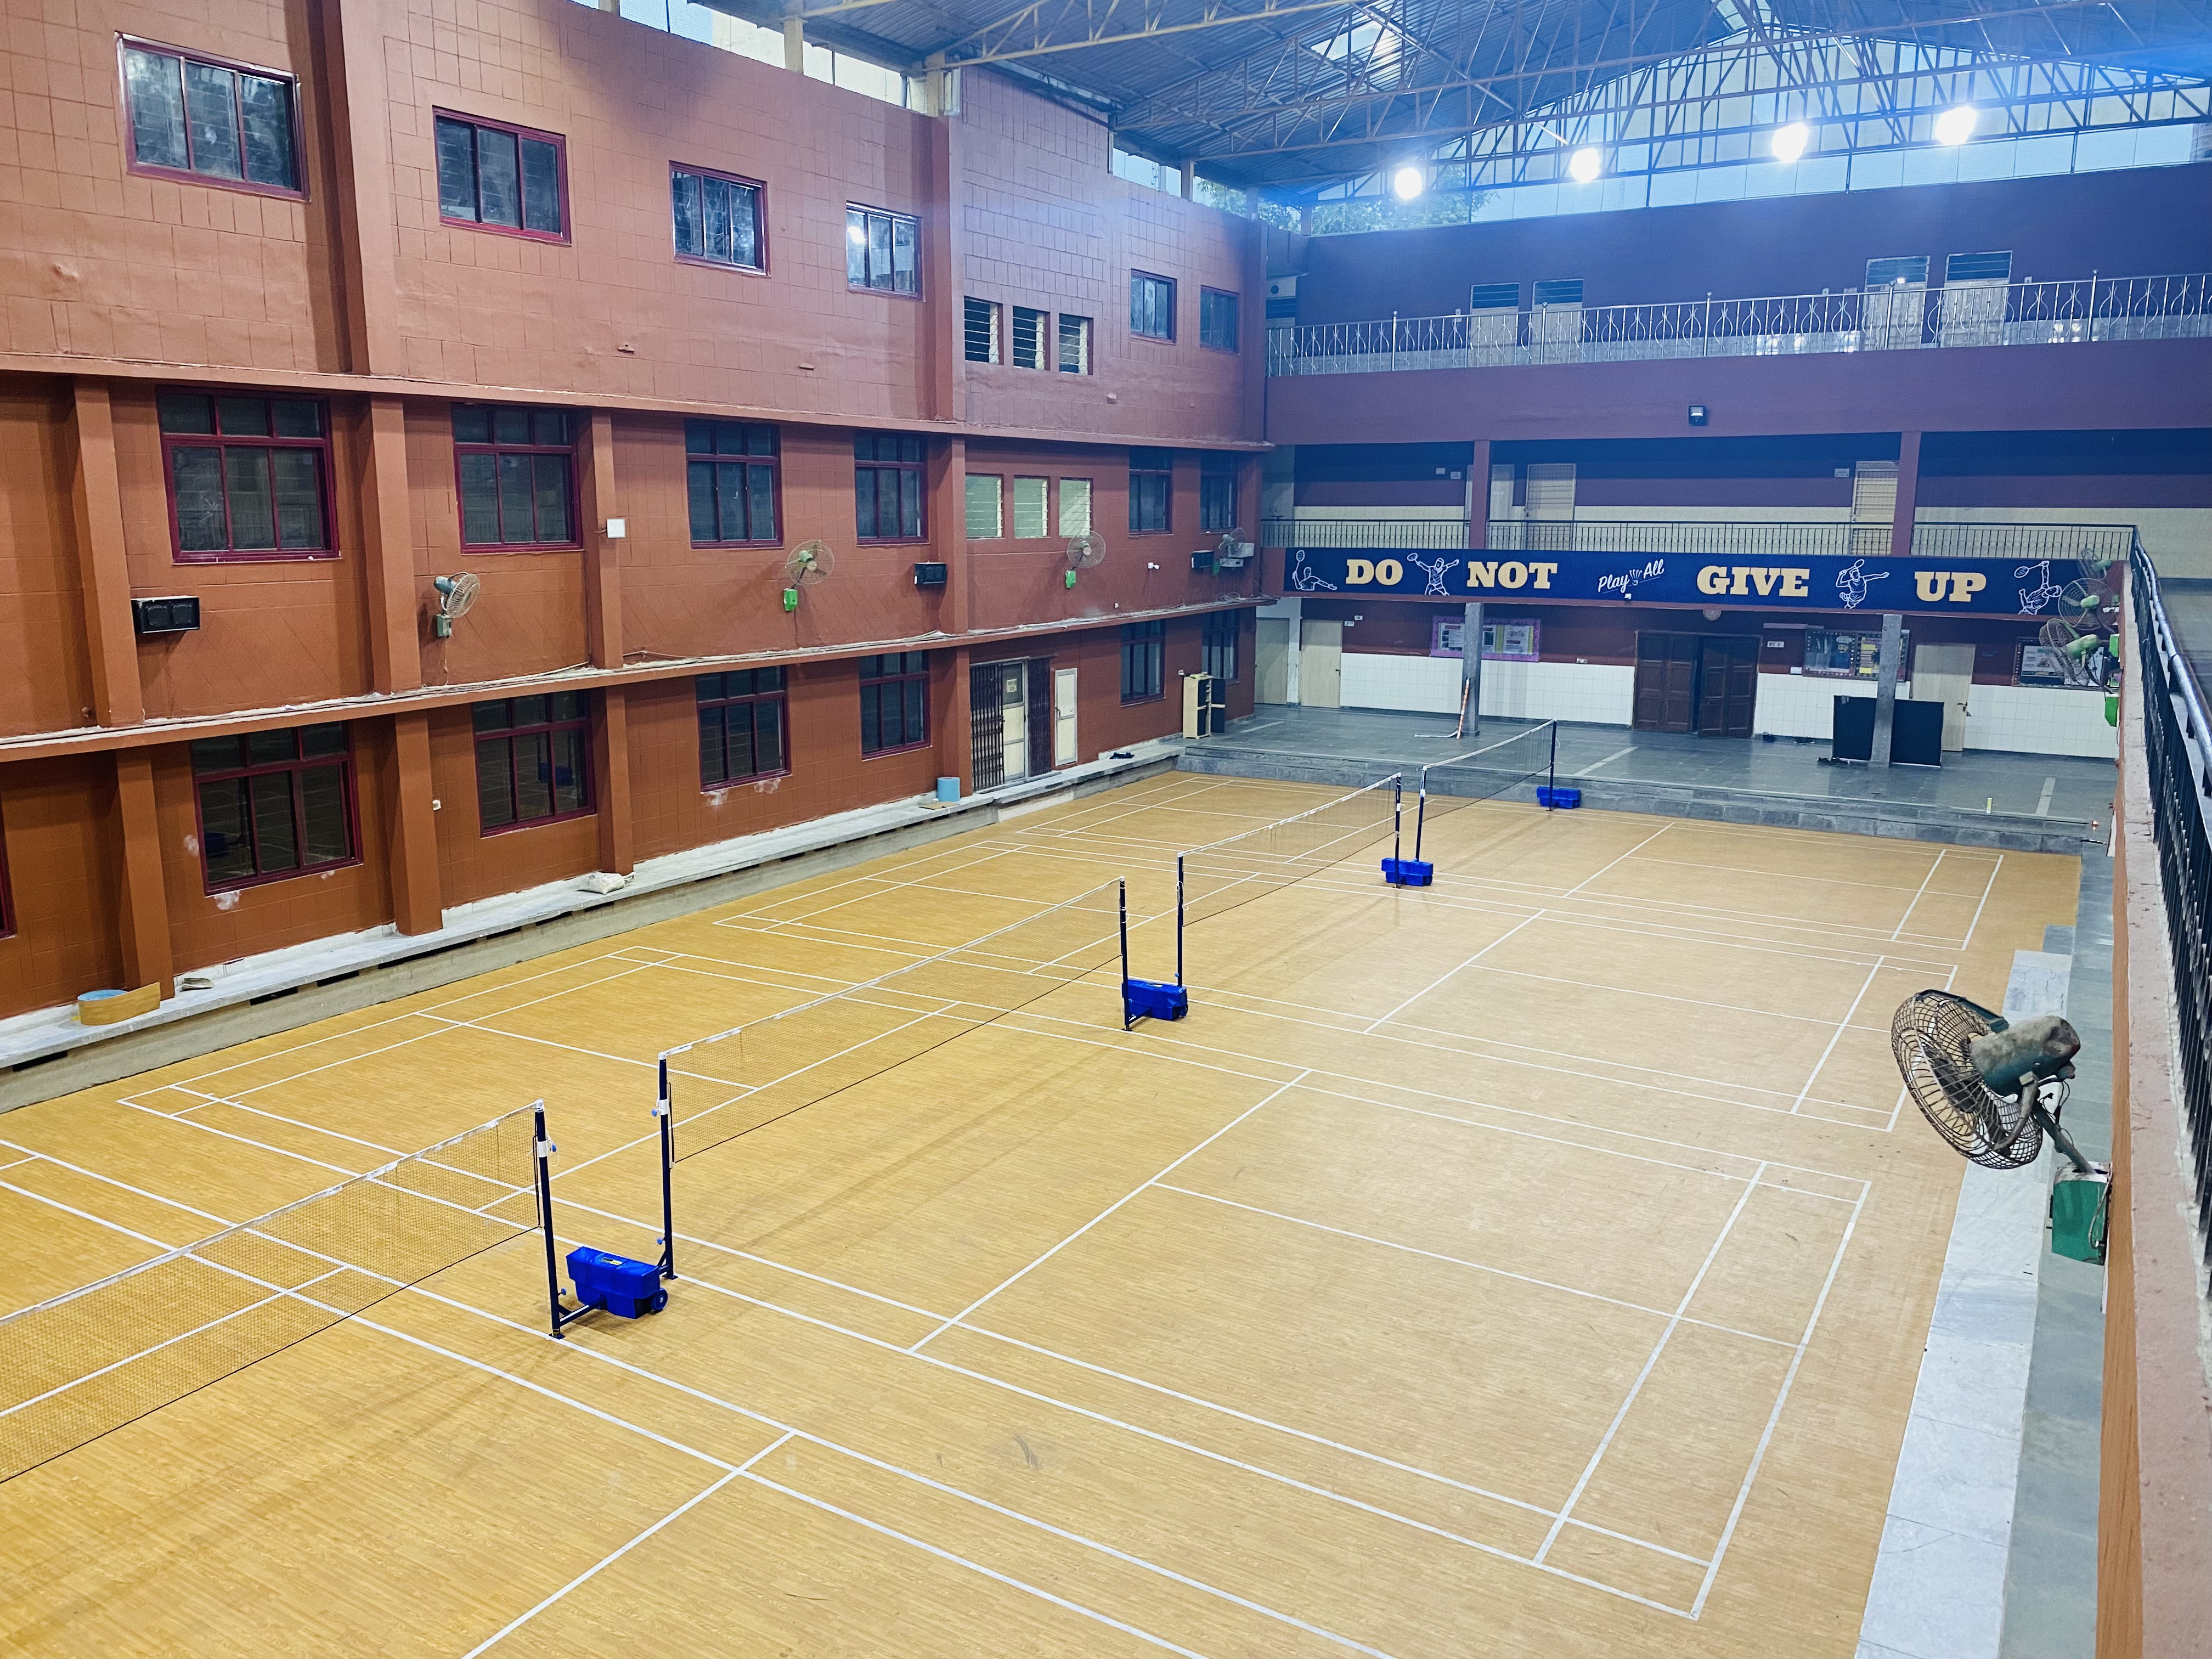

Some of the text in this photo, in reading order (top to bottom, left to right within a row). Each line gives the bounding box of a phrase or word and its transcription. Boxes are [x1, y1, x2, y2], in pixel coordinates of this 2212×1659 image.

[1346, 558, 1987, 602] DO NOT GIVE UP
[1598, 558, 1664, 594] Play All
